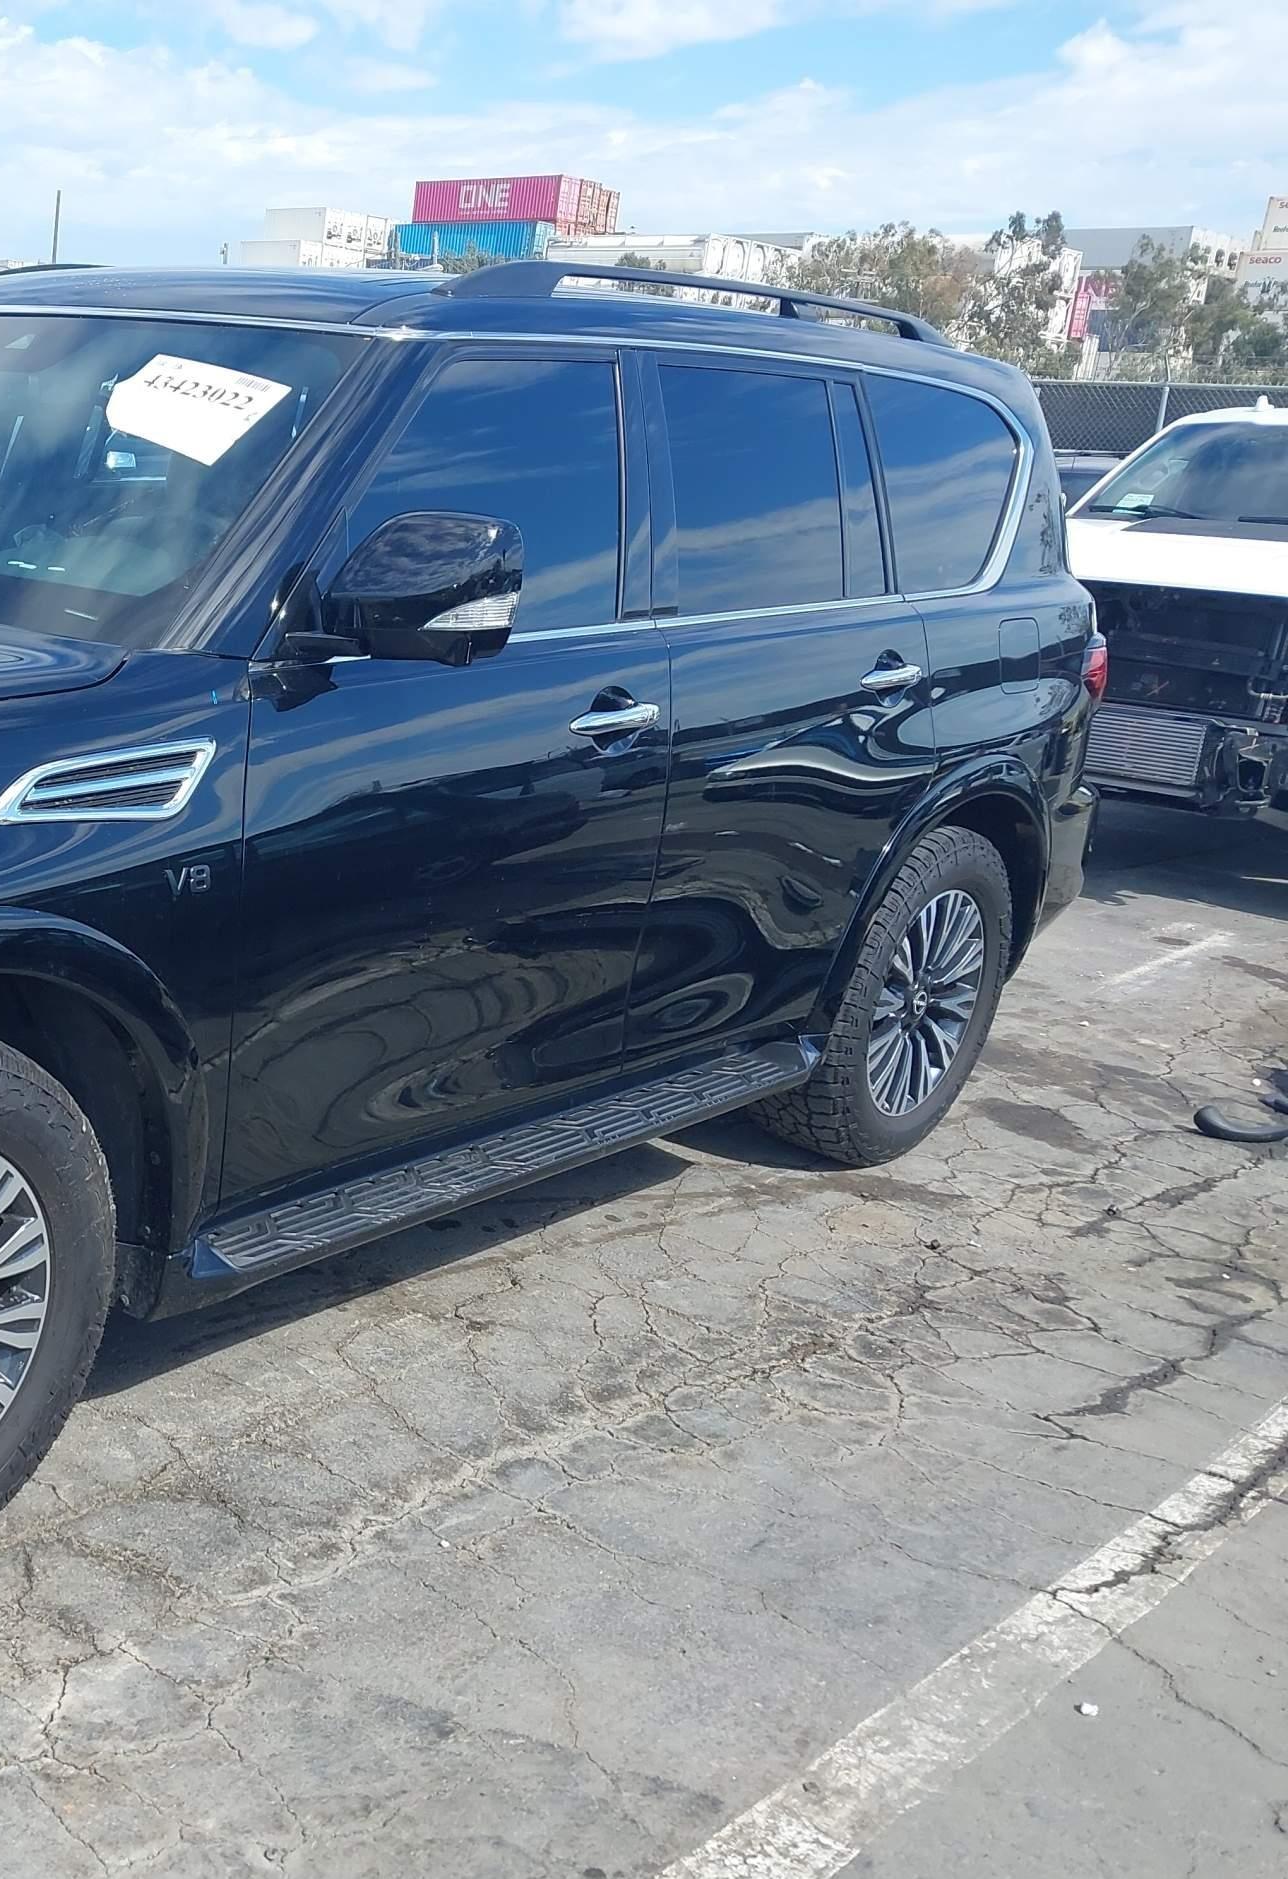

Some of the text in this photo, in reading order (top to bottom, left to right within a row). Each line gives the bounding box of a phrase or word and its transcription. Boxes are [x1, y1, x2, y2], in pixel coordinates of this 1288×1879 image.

[459, 184, 510, 208] ONE
[1249, 256, 1282, 265] seaco
[143, 374, 254, 410] 43423022
[162, 864, 211, 896] V8
